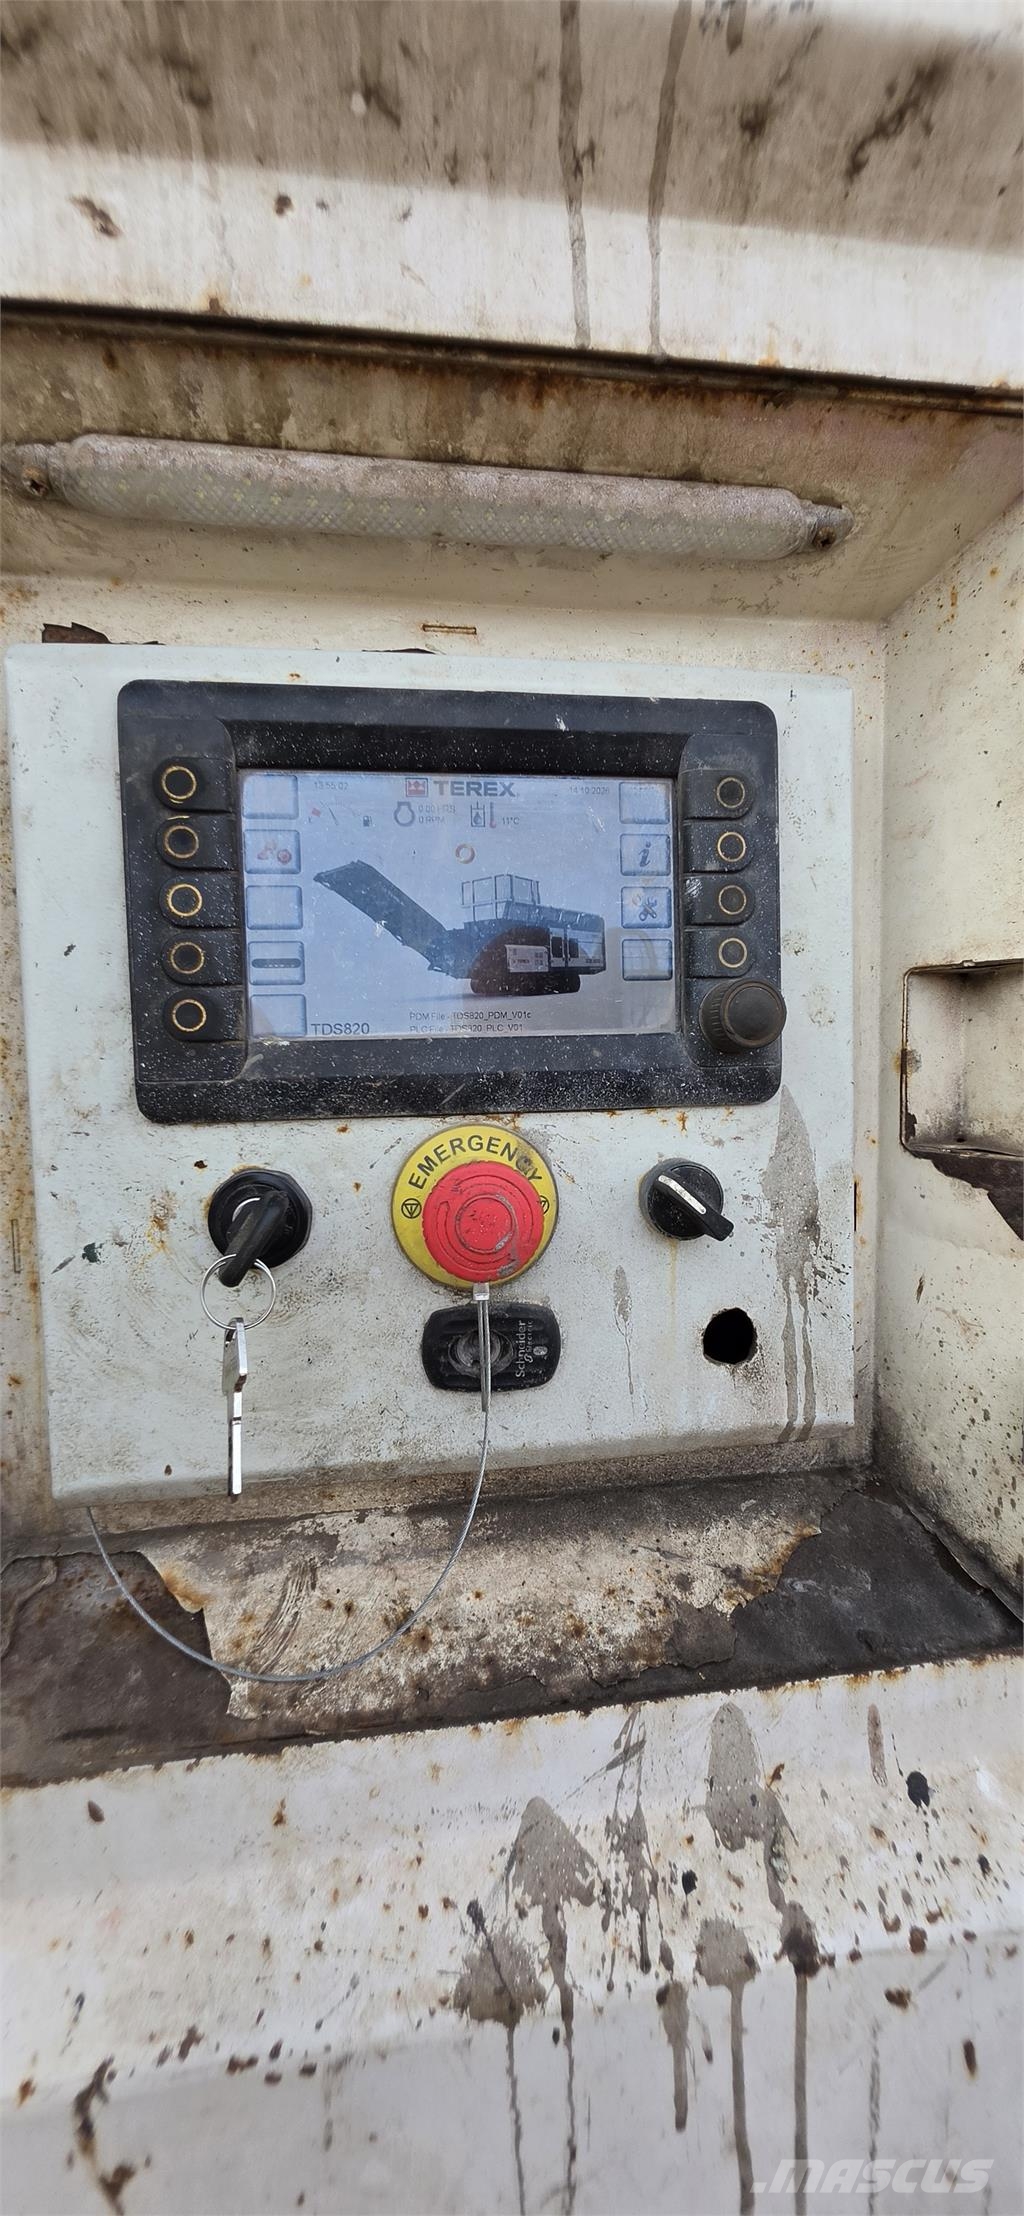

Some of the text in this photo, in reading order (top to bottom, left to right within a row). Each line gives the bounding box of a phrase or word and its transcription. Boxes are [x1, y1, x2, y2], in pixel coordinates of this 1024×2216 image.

[433, 780, 516, 797] TEREX
[409, 1011, 430, 1021] PDM
[311, 1023, 370, 1035] TDS820
[408, 1134, 542, 1190] EMERGENCY
[515, 1319, 527, 1378] Schneider
